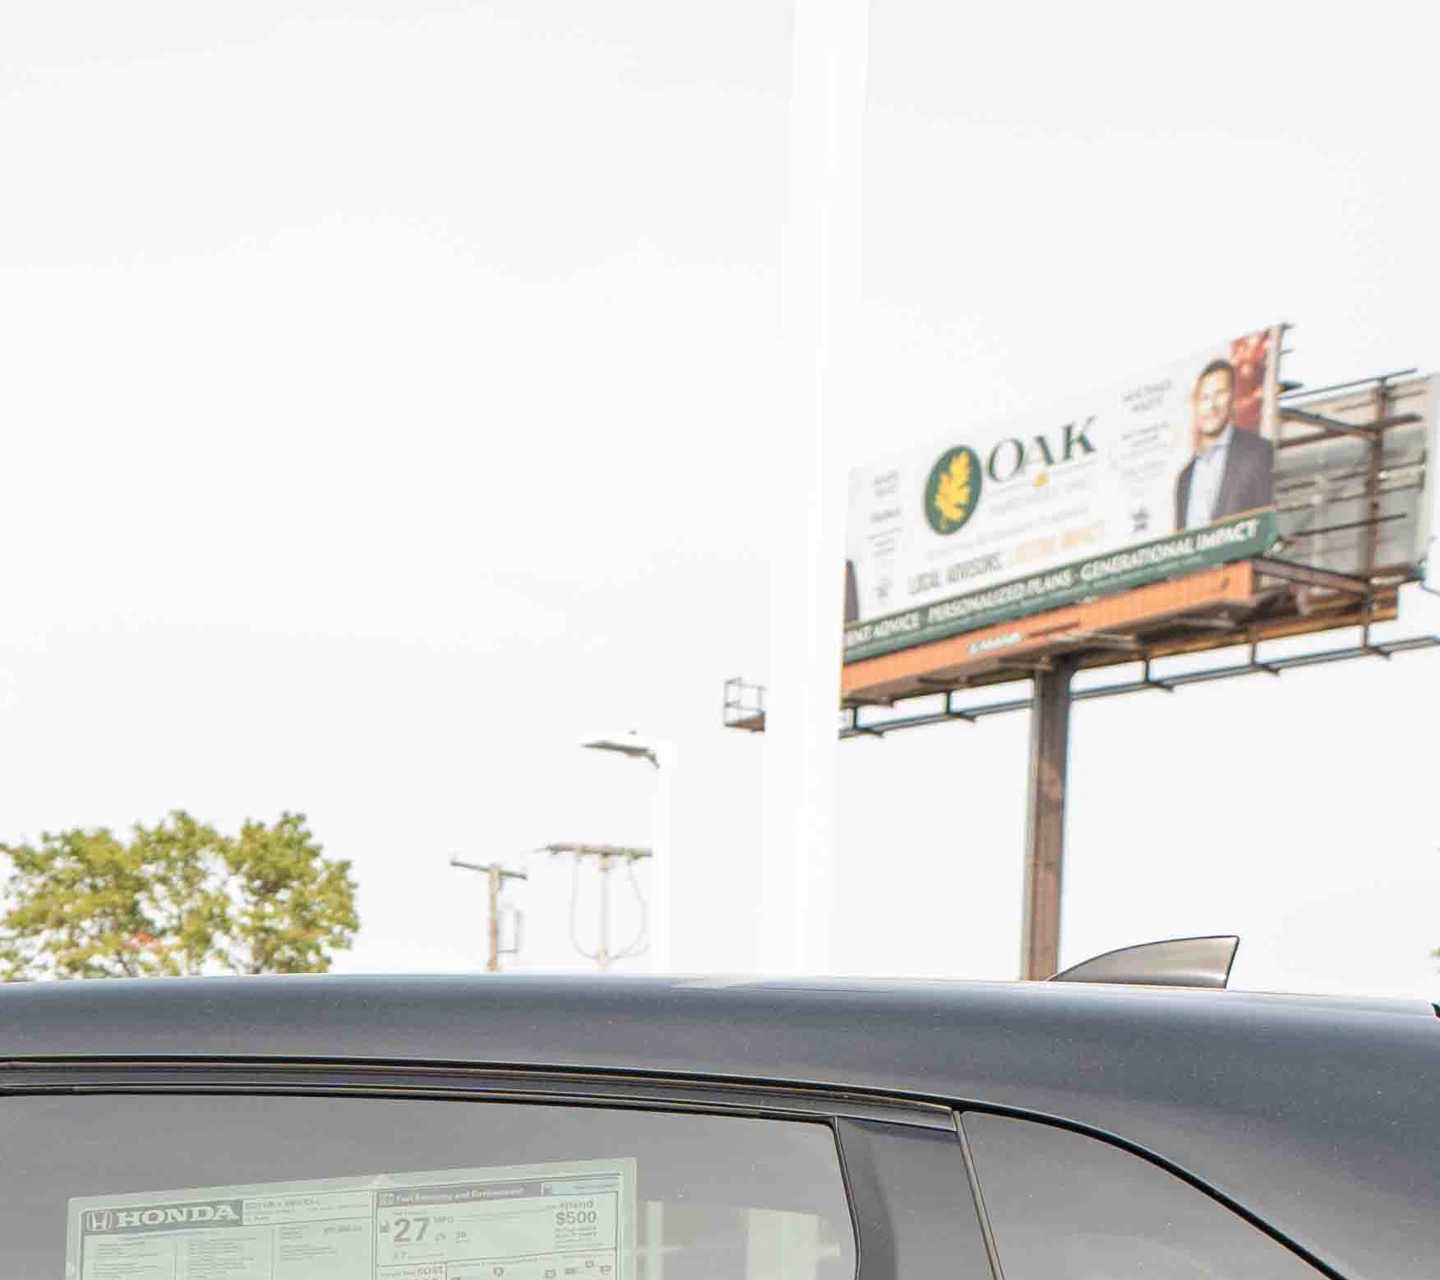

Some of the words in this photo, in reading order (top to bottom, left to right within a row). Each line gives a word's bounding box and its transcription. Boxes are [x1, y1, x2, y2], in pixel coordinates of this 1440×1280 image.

[987, 414, 1098, 484] OAK
[926, 583, 1025, 623] PERSONALIZED
[1026, 569, 1073, 597] PLANS
[1079, 538, 1196, 582] GENERATIONAL
[1196, 518, 1261, 549] IMPACT
[116, 1204, 240, 1228] HONDA
[393, 1216, 431, 1243] 27
[555, 1210, 598, 1226] $500
